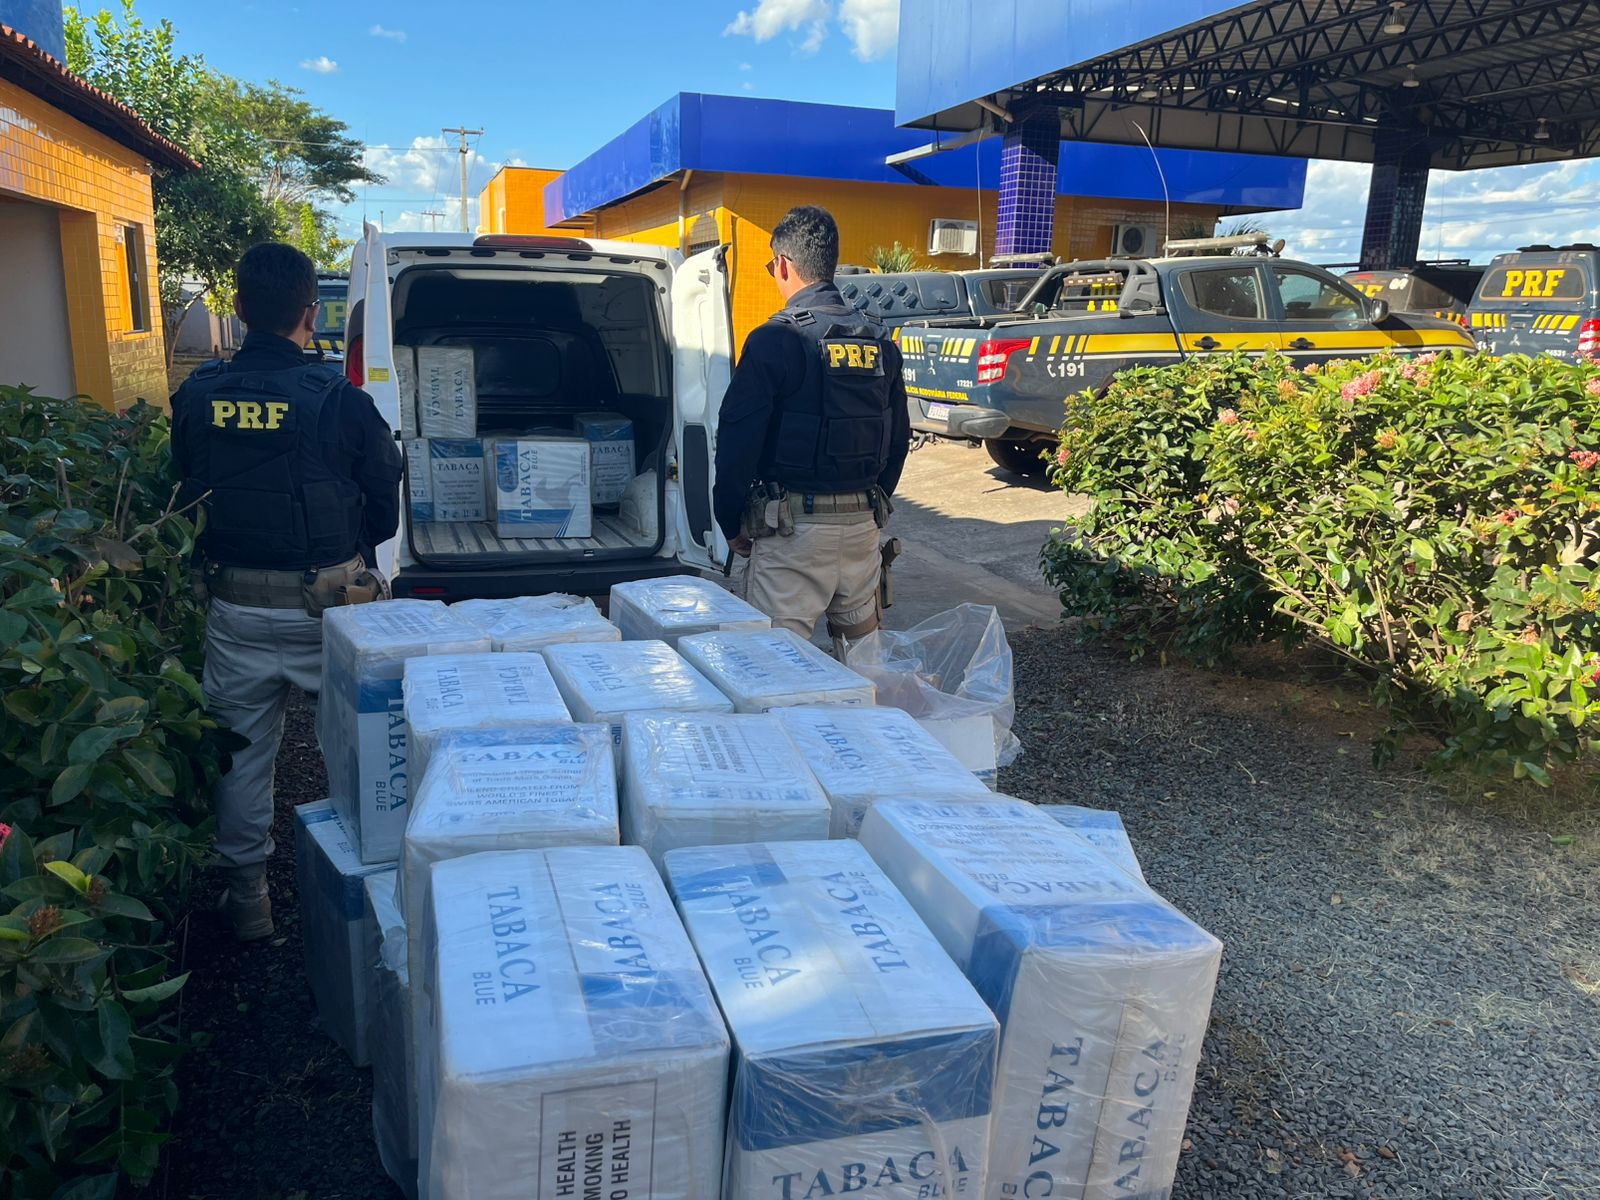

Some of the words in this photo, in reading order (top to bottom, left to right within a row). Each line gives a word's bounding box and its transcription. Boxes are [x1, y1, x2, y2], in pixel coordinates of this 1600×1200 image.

[1501, 269, 1566, 297] PRF
[828, 344, 879, 370] PRF
[903, 367, 917, 382] 191
[1057, 362, 1085, 378] 191
[454, 369, 464, 418] TABACA
[211, 400, 289, 430] PRF
[436, 462, 480, 472] TABACA
[530, 449, 539, 470] BLUE
[519, 449, 532, 520] TABACA
[436, 667, 465, 709] TABACA
[496, 666, 531, 705] TABACA
[387, 690, 408, 812] TABACA
[461, 751, 588, 762] TABACA
[814, 723, 867, 770] TABACA
[375, 780, 387, 812] BLUE
[720, 872, 802, 987] TABACA
[820, 870, 911, 975] TABACA
[486, 885, 542, 1004] TABACA
[472, 970, 497, 1006] BLUE
[733, 956, 765, 990] BLUE
[556, 1130, 577, 1197] HEALTH
[610, 1119, 632, 1185] HEALTH
[772, 1145, 970, 1200] TABACA
